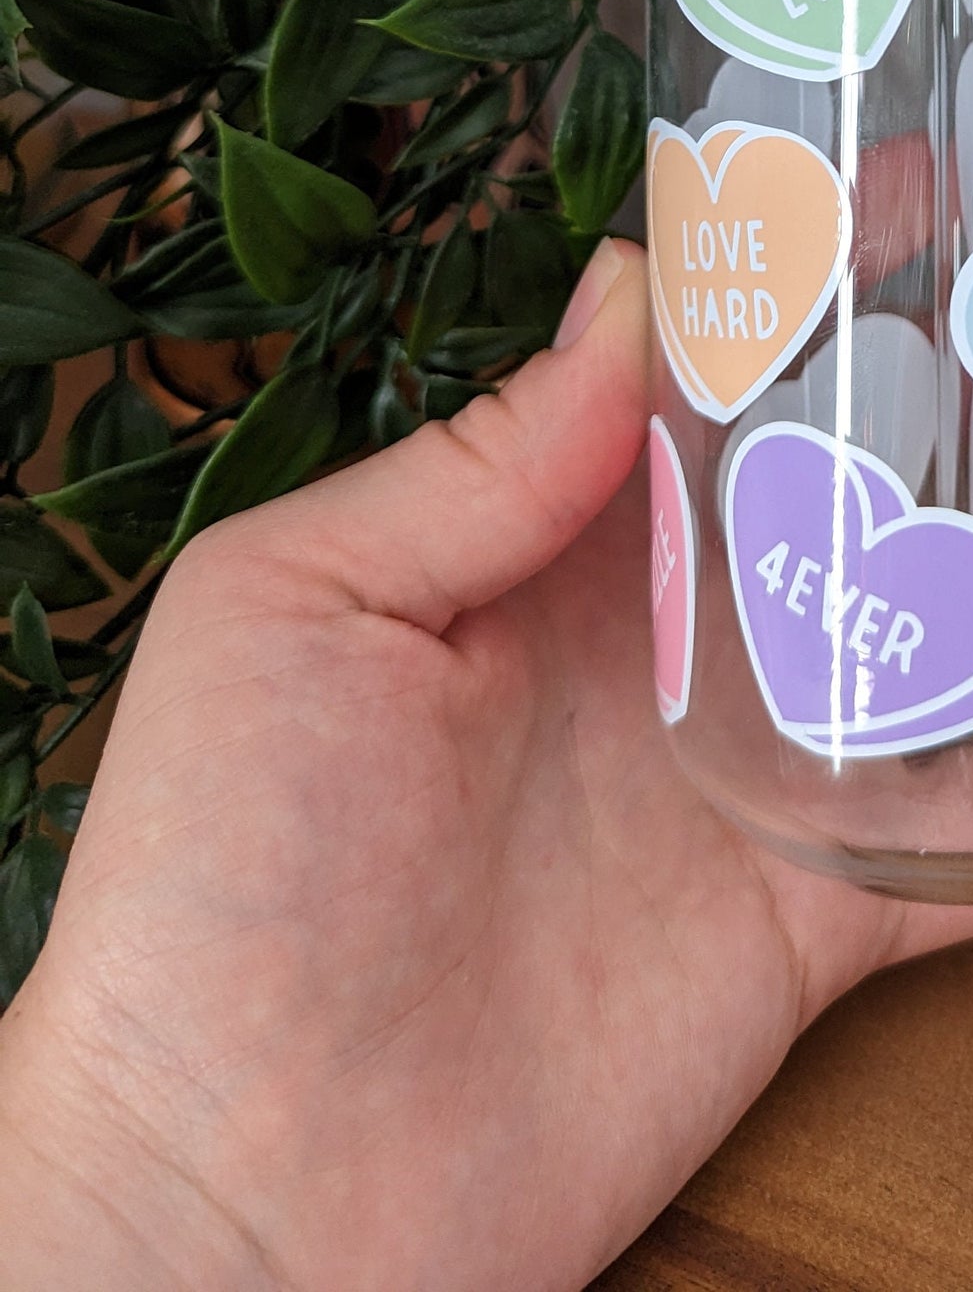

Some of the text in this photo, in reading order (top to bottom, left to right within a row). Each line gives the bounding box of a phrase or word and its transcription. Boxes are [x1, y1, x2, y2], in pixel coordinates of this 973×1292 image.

[682, 219, 767, 273] LOVE
[682, 288, 780, 341] HARD
[755, 539, 926, 675] 4EVER
